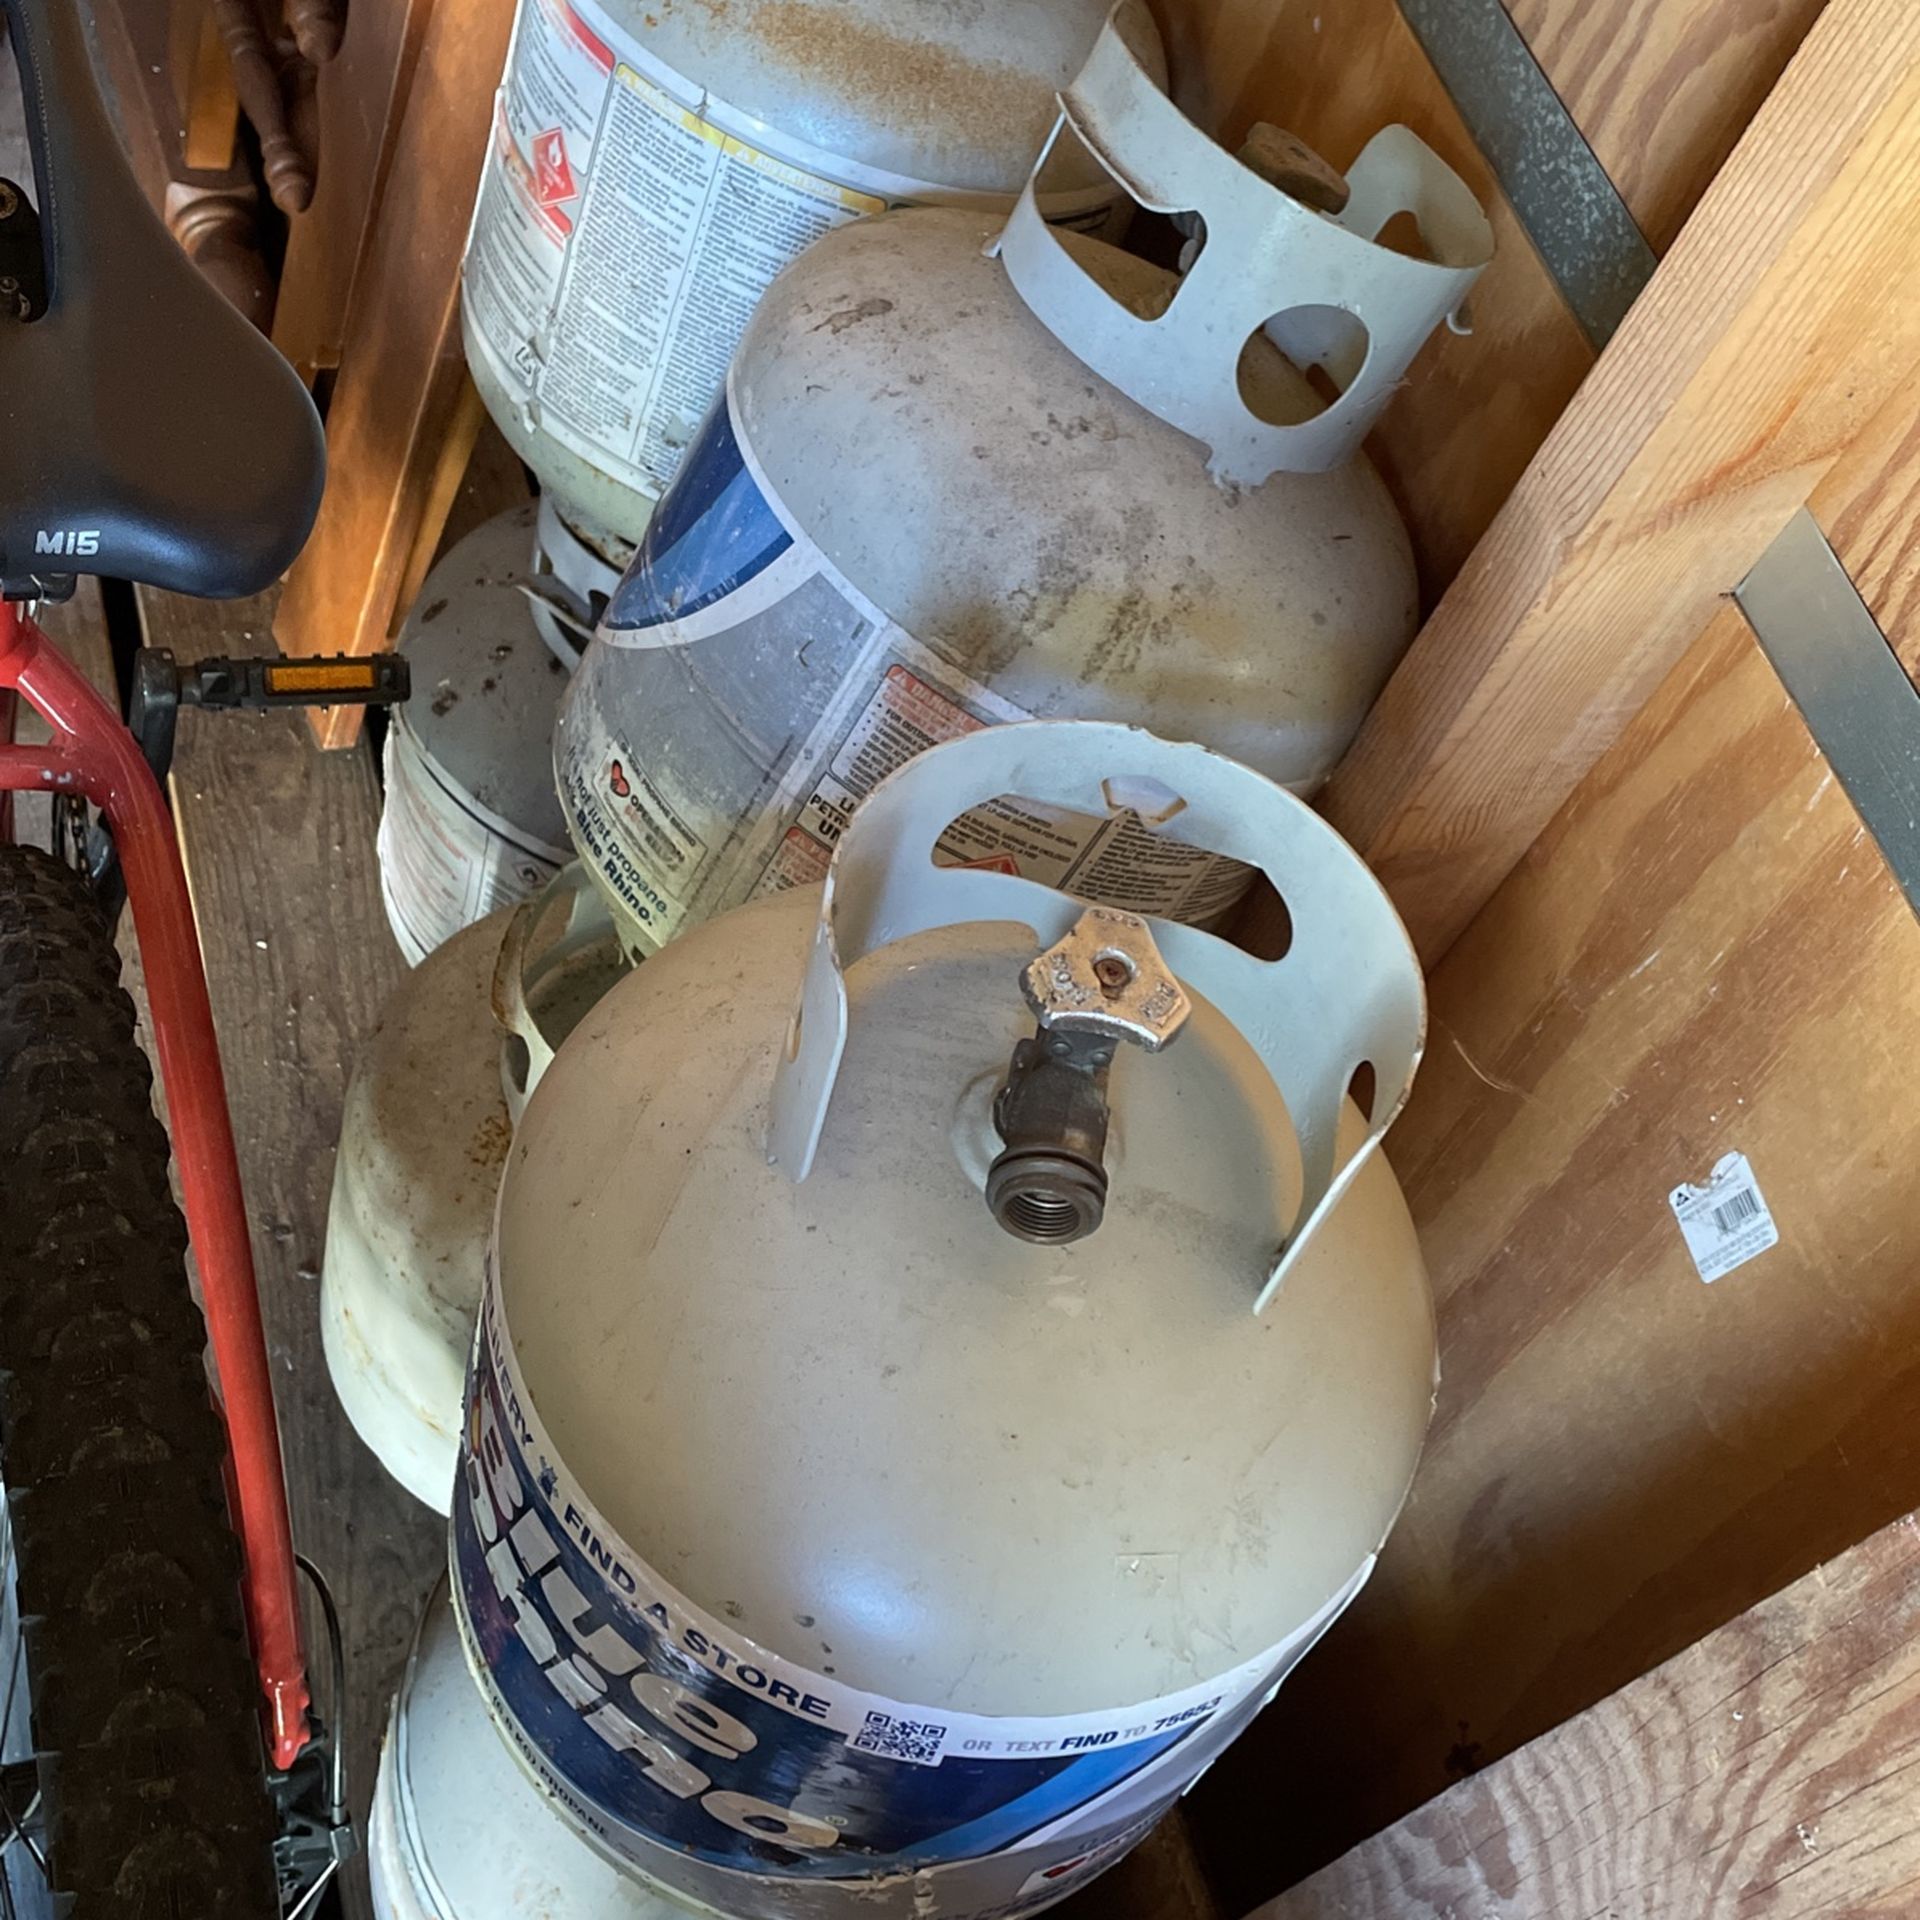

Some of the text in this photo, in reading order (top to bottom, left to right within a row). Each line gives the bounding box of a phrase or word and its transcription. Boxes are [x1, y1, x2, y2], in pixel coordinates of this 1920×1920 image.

[576, 809, 603, 858] Blue
[603, 859, 653, 928] Rhino.
[588, 806, 612, 843] just
[607, 841, 668, 919] propane.
[480, 1383, 758, 1760] Blue
[564, 1503, 831, 1719] FIND A STORE
[963, 1739, 993, 1751] OR
[1005, 1740, 1057, 1752] TEXT
[1059, 1730, 1119, 1750] FIND
[1123, 1725, 1147, 1739] TO
[540, 1765, 607, 1835] PROPANE
